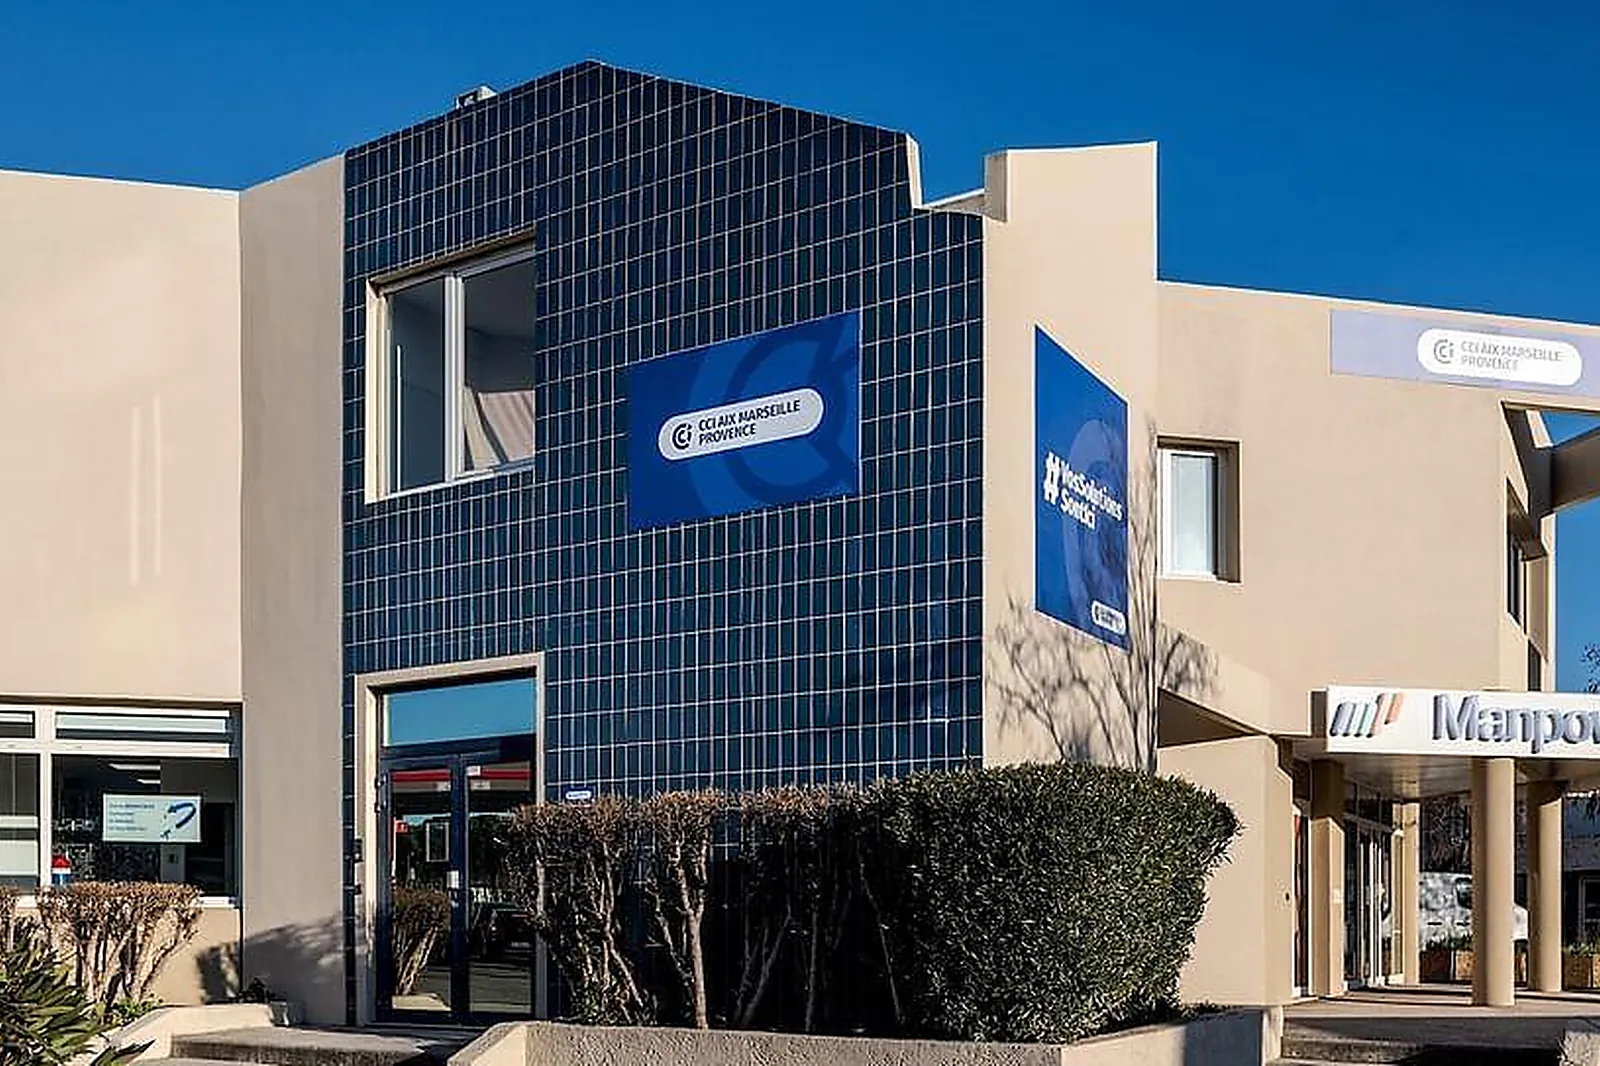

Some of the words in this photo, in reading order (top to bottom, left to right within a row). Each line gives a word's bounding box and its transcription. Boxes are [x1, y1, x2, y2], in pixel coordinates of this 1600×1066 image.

[1480, 342, 1499, 355] AIX
[699, 418, 716, 431] CCI
[718, 413, 736, 428] AIX
[738, 400, 800, 423] MARSEILLE
[699, 423, 756, 446] PROVENCE
[1432, 693, 1600, 754] Manpo
